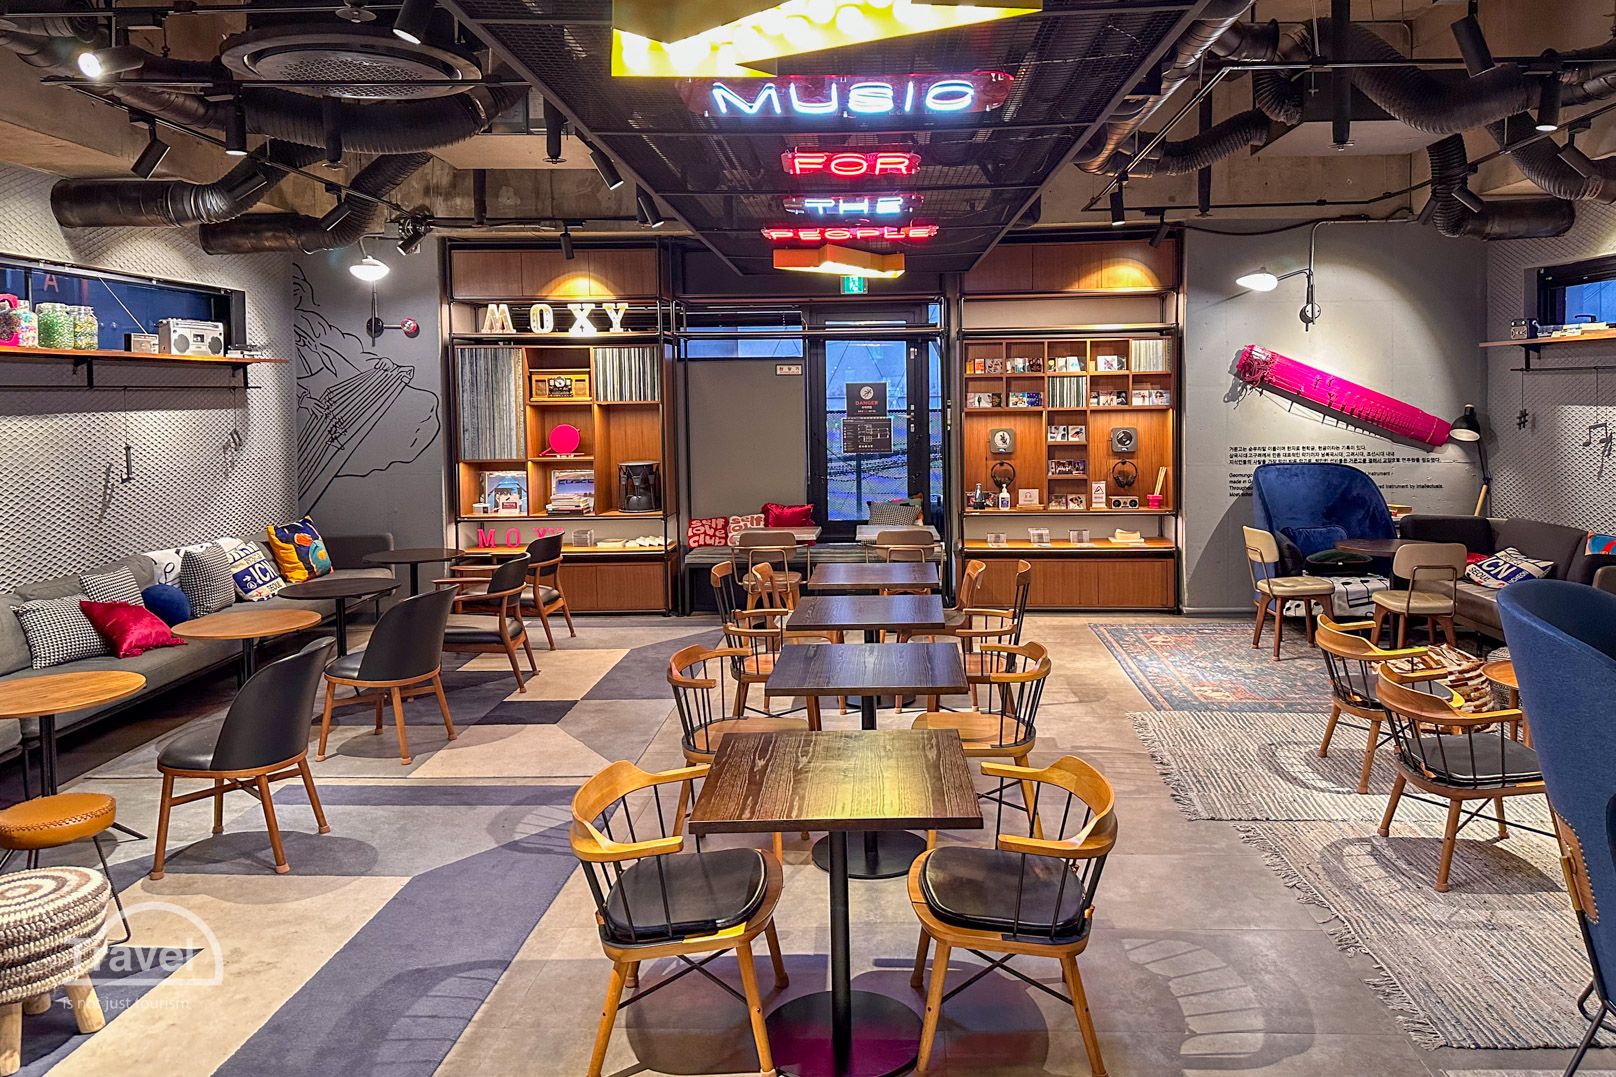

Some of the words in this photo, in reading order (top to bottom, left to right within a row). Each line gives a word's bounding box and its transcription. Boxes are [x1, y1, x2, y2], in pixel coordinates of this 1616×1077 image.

[712, 80, 975, 114] MUSIC
[794, 152, 910, 176] FOR
[804, 197, 904, 214] THE
[770, 227, 936, 240] PEOPLE
[481, 302, 629, 336] MOXY
[687, 525, 727, 538] love
[690, 517, 726, 529] self
[478, 528, 565, 549] MO
[688, 534, 726, 548] club
[248, 559, 278, 585] ICN
[1469, 566, 1491, 582] SEOUL
